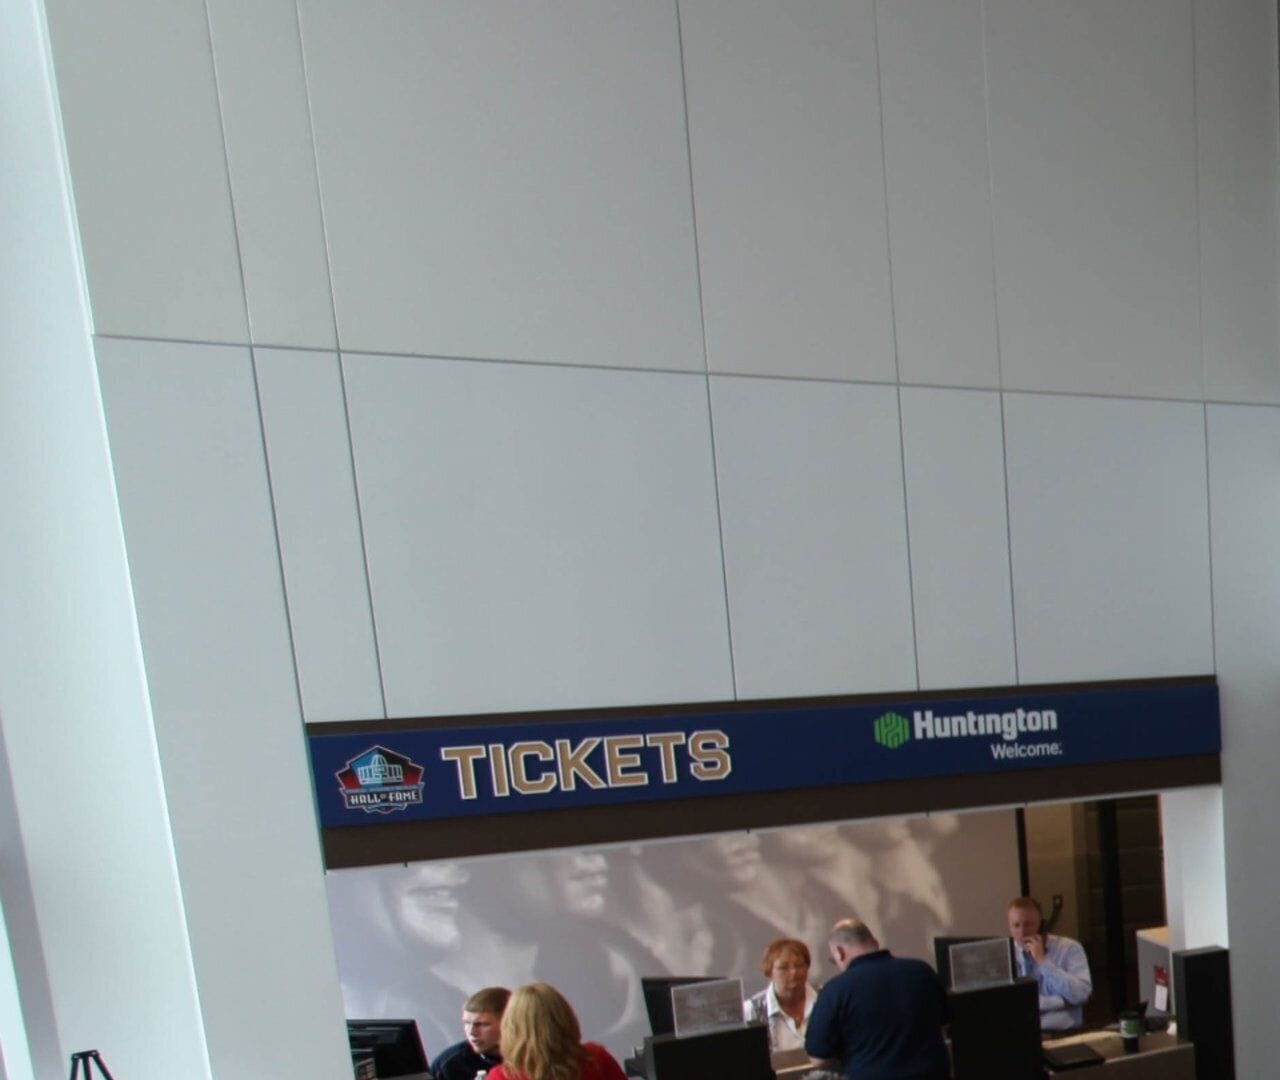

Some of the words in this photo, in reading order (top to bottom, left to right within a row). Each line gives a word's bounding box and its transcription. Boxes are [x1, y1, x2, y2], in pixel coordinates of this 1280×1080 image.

[913, 708, 1058, 741] Huntington
[441, 729, 733, 800] TICKETS
[350, 793, 382, 805] HALL
[388, 790, 419, 802] FAME
